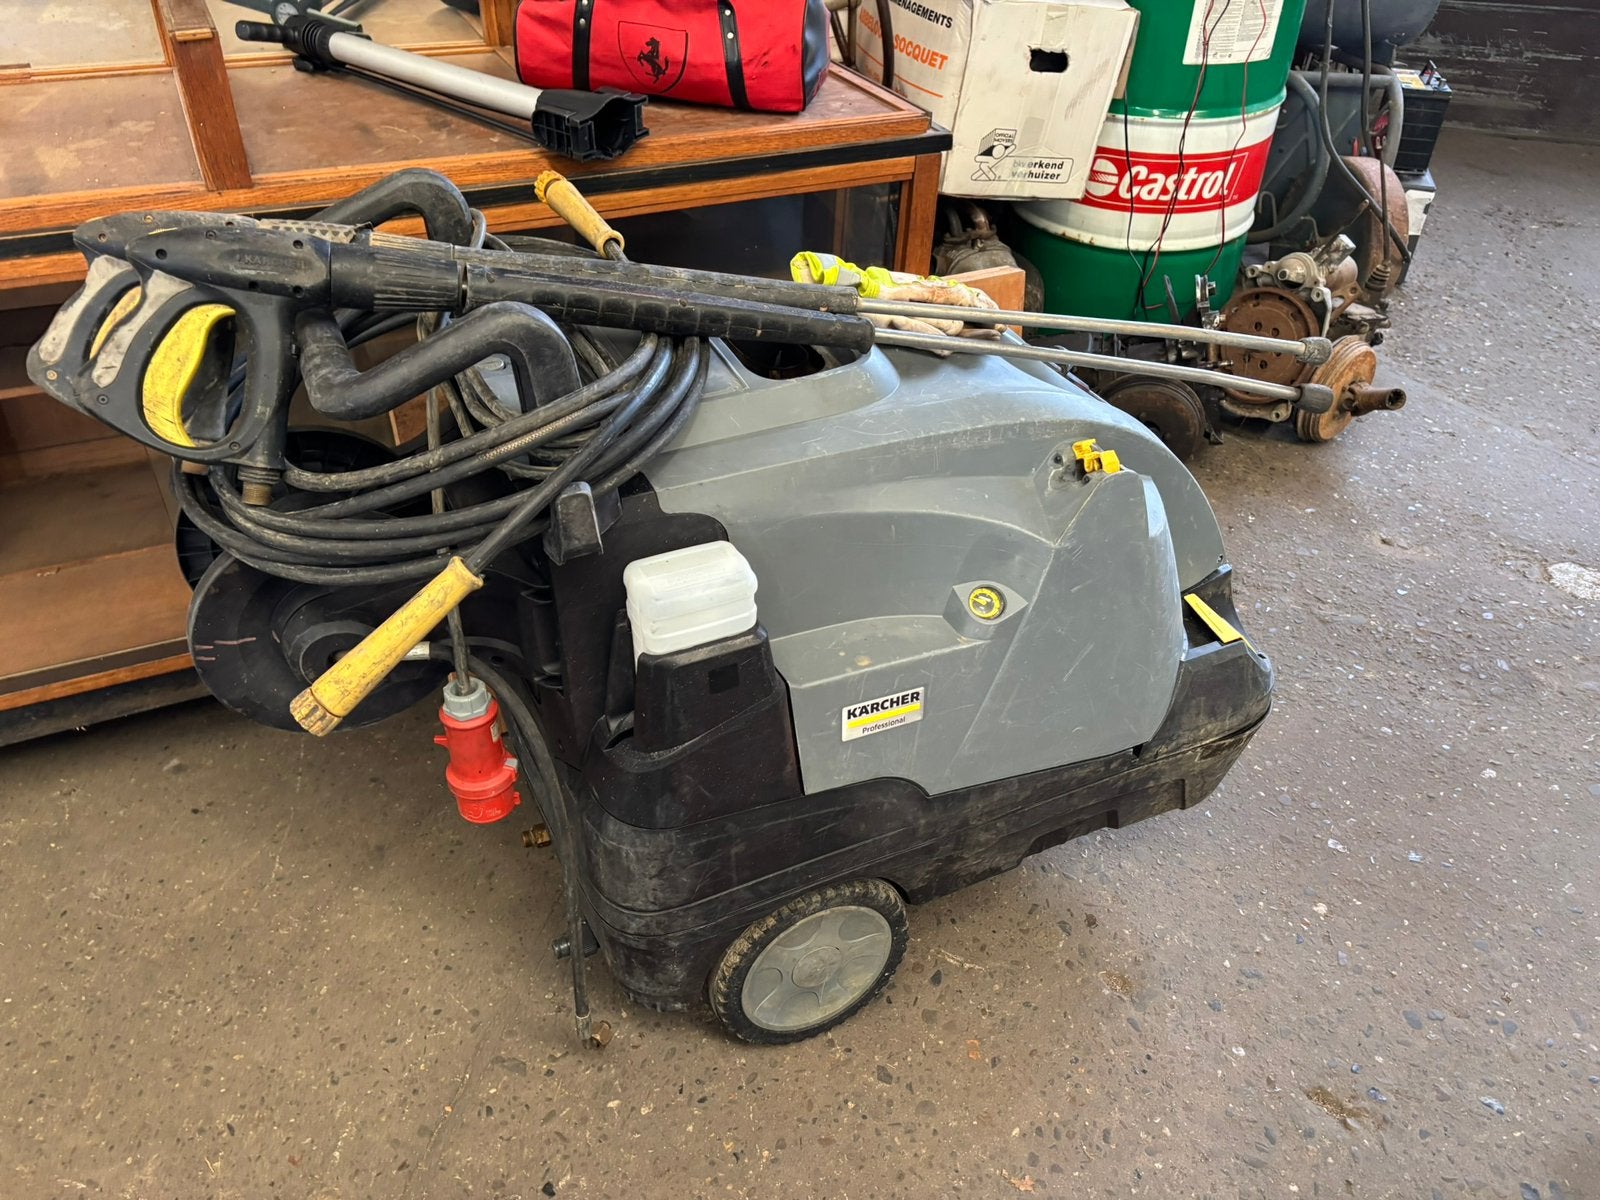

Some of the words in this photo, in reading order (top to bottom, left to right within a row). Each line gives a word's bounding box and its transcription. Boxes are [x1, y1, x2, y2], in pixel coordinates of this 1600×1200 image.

[894, 34, 948, 70] SOCQUET
[1011, 170, 1060, 180] verhuizer
[1118, 162, 1237, 200] Castrol
[847, 691, 920, 720] KÄRCHER
[862, 716, 906, 734] Professional
